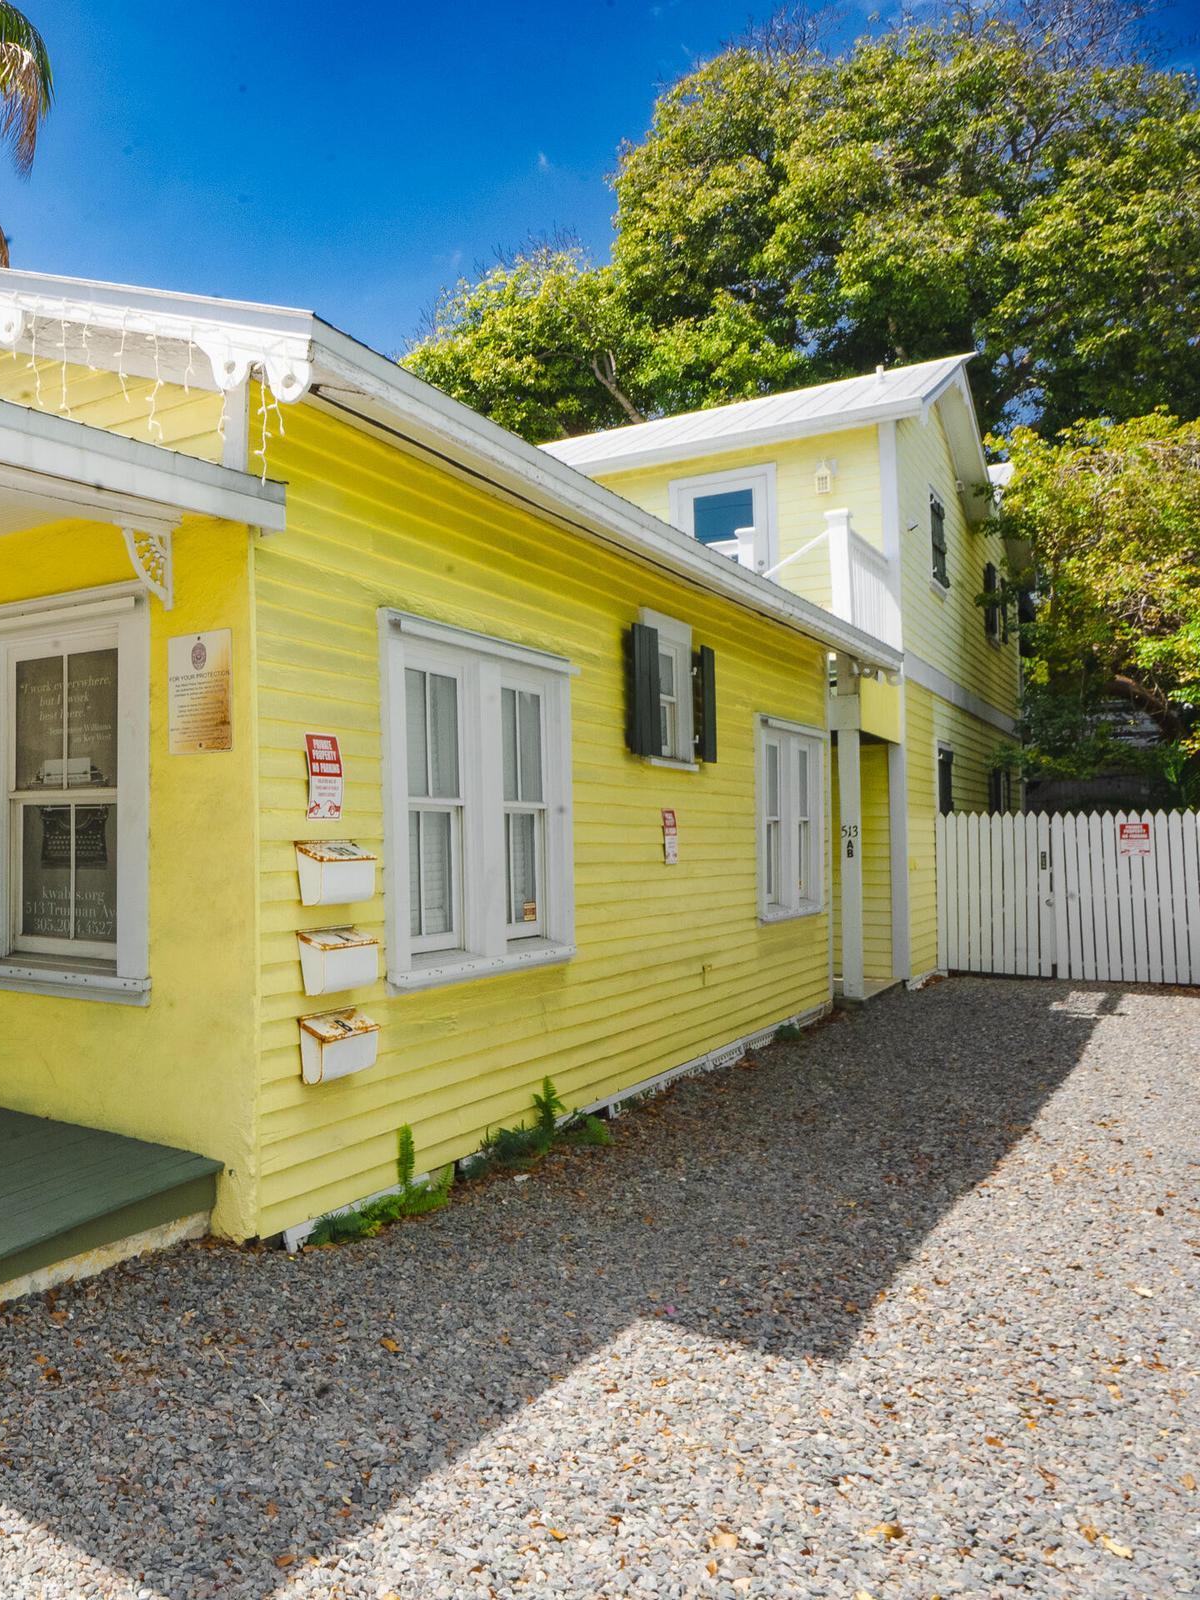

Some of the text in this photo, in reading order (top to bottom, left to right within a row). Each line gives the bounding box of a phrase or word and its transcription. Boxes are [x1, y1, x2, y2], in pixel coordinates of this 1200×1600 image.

[841, 825, 859, 838] 513
[846, 839, 854, 849] A
[846, 849, 854, 858] B
